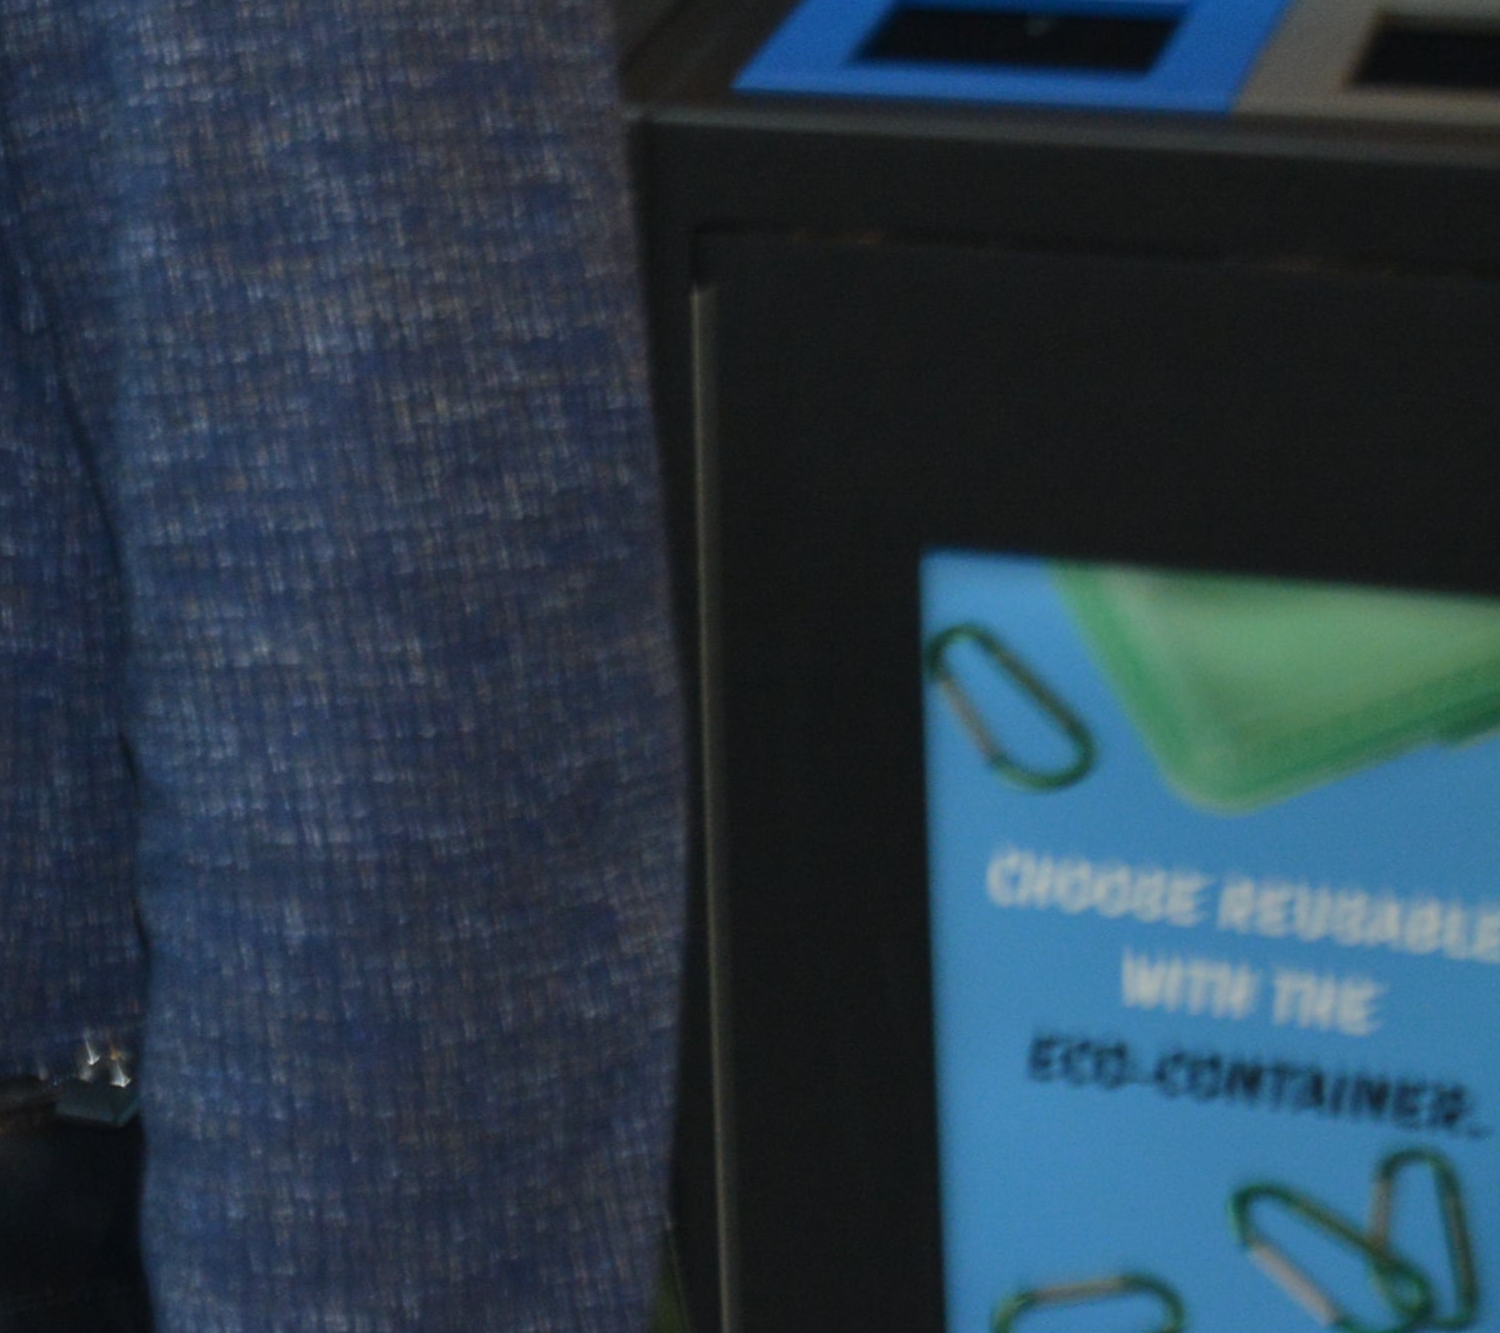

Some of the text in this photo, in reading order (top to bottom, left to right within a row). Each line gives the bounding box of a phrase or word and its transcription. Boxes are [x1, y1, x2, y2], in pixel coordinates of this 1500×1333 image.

[986, 846, 1206, 927] CHOOSE
[1121, 947, 1386, 1037] WITH THE
